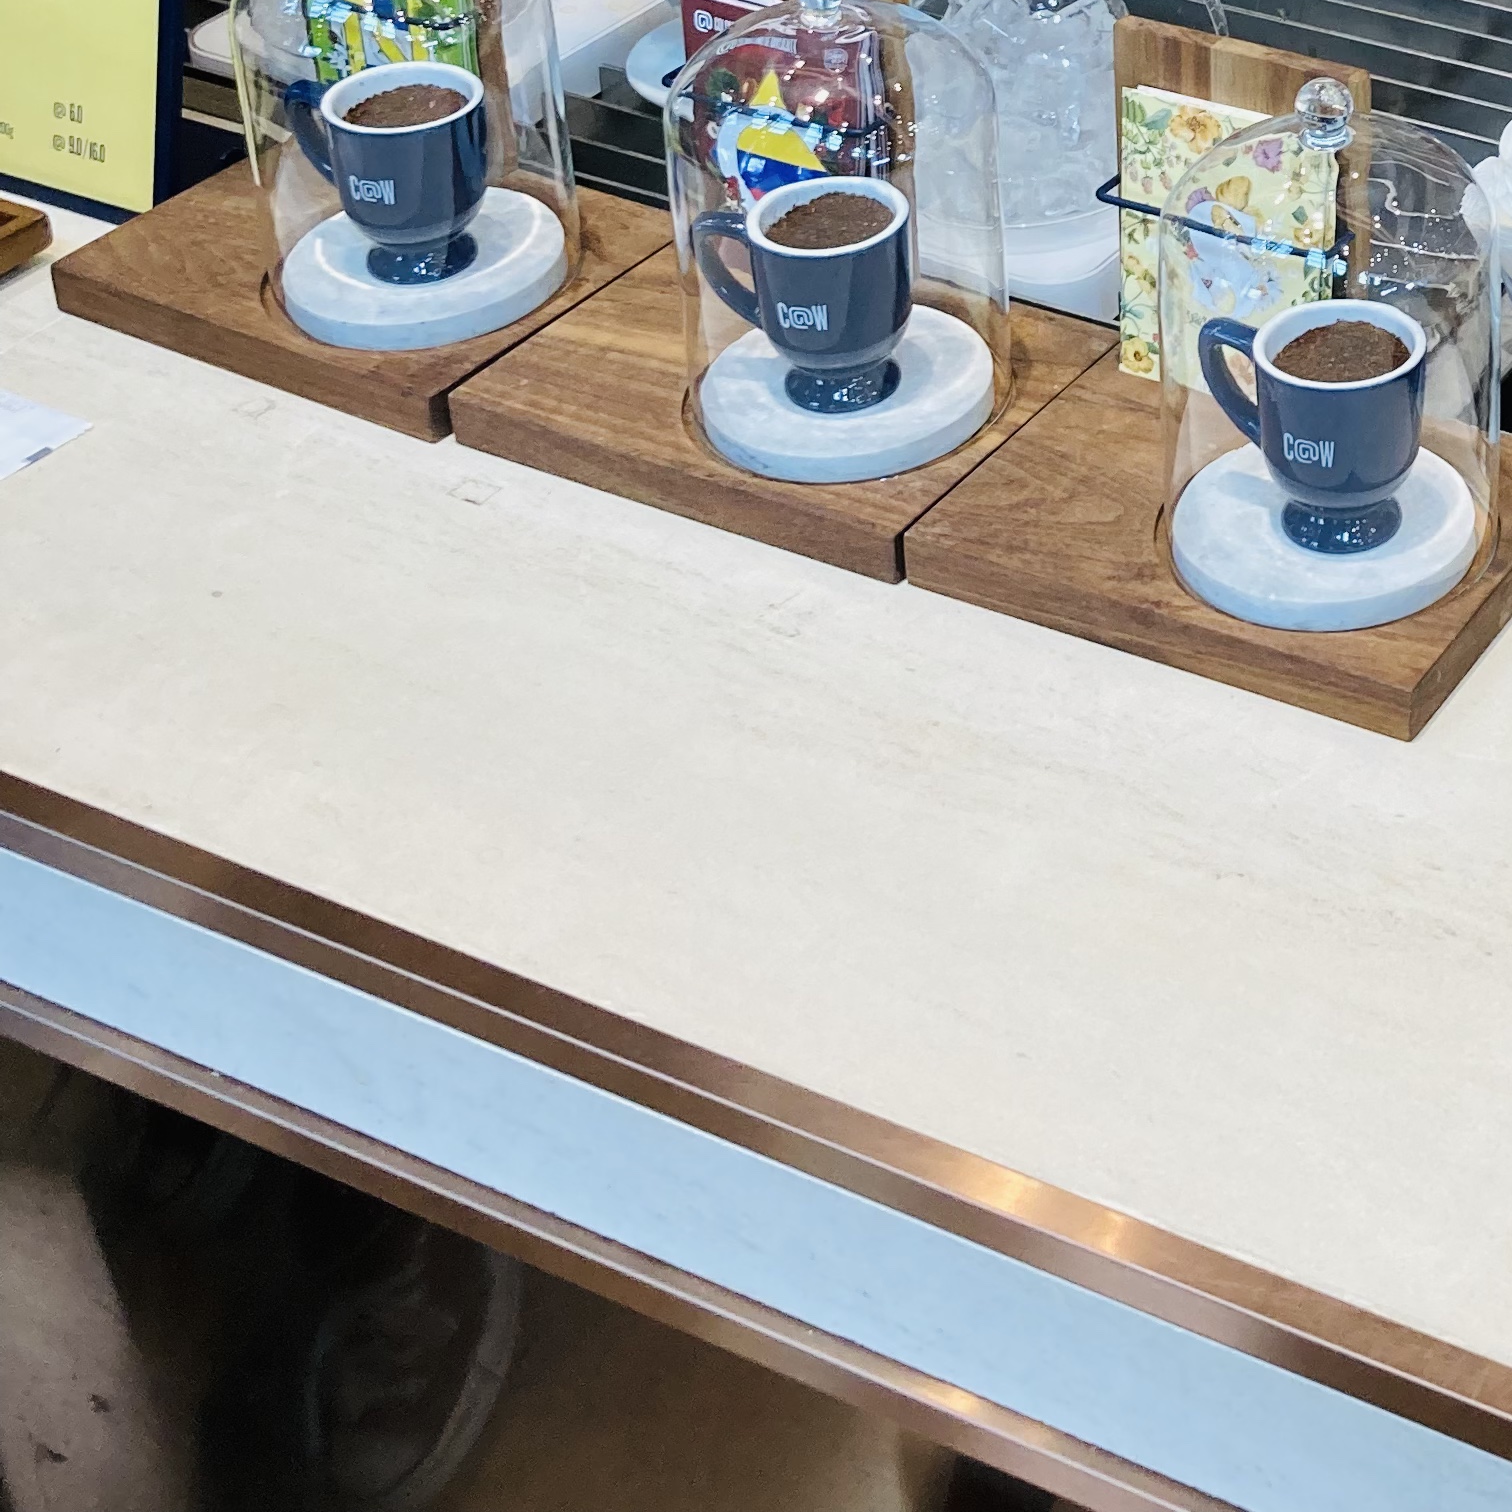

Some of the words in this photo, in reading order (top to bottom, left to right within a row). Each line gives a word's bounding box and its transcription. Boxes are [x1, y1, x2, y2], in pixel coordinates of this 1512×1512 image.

[349, 175, 395, 205] C@W
[777, 302, 828, 331] C@W
[1283, 432, 1334, 468] C@W
